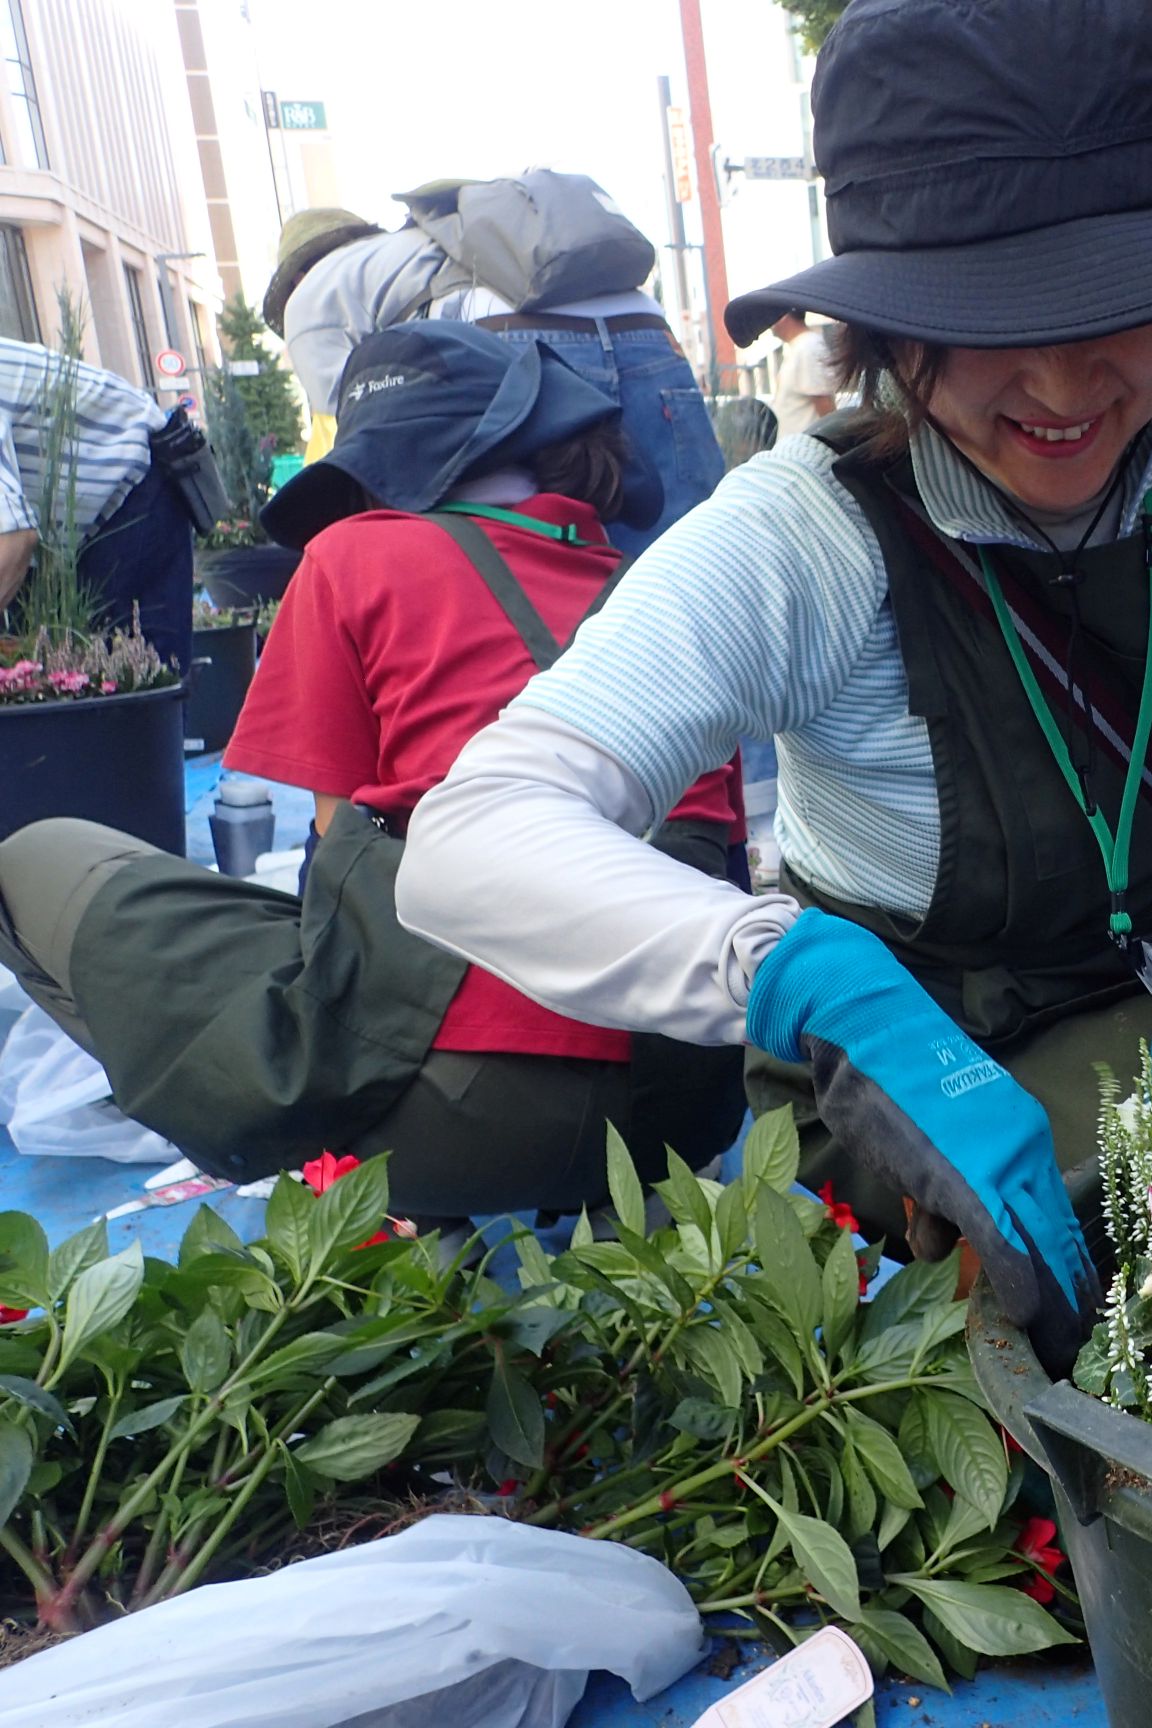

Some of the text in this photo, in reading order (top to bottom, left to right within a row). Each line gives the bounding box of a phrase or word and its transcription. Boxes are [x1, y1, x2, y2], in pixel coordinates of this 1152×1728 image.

[368, 374, 405, 394] Foxfire
[936, 1047, 957, 1067] M
[942, 1064, 994, 1097] TAKUMI
